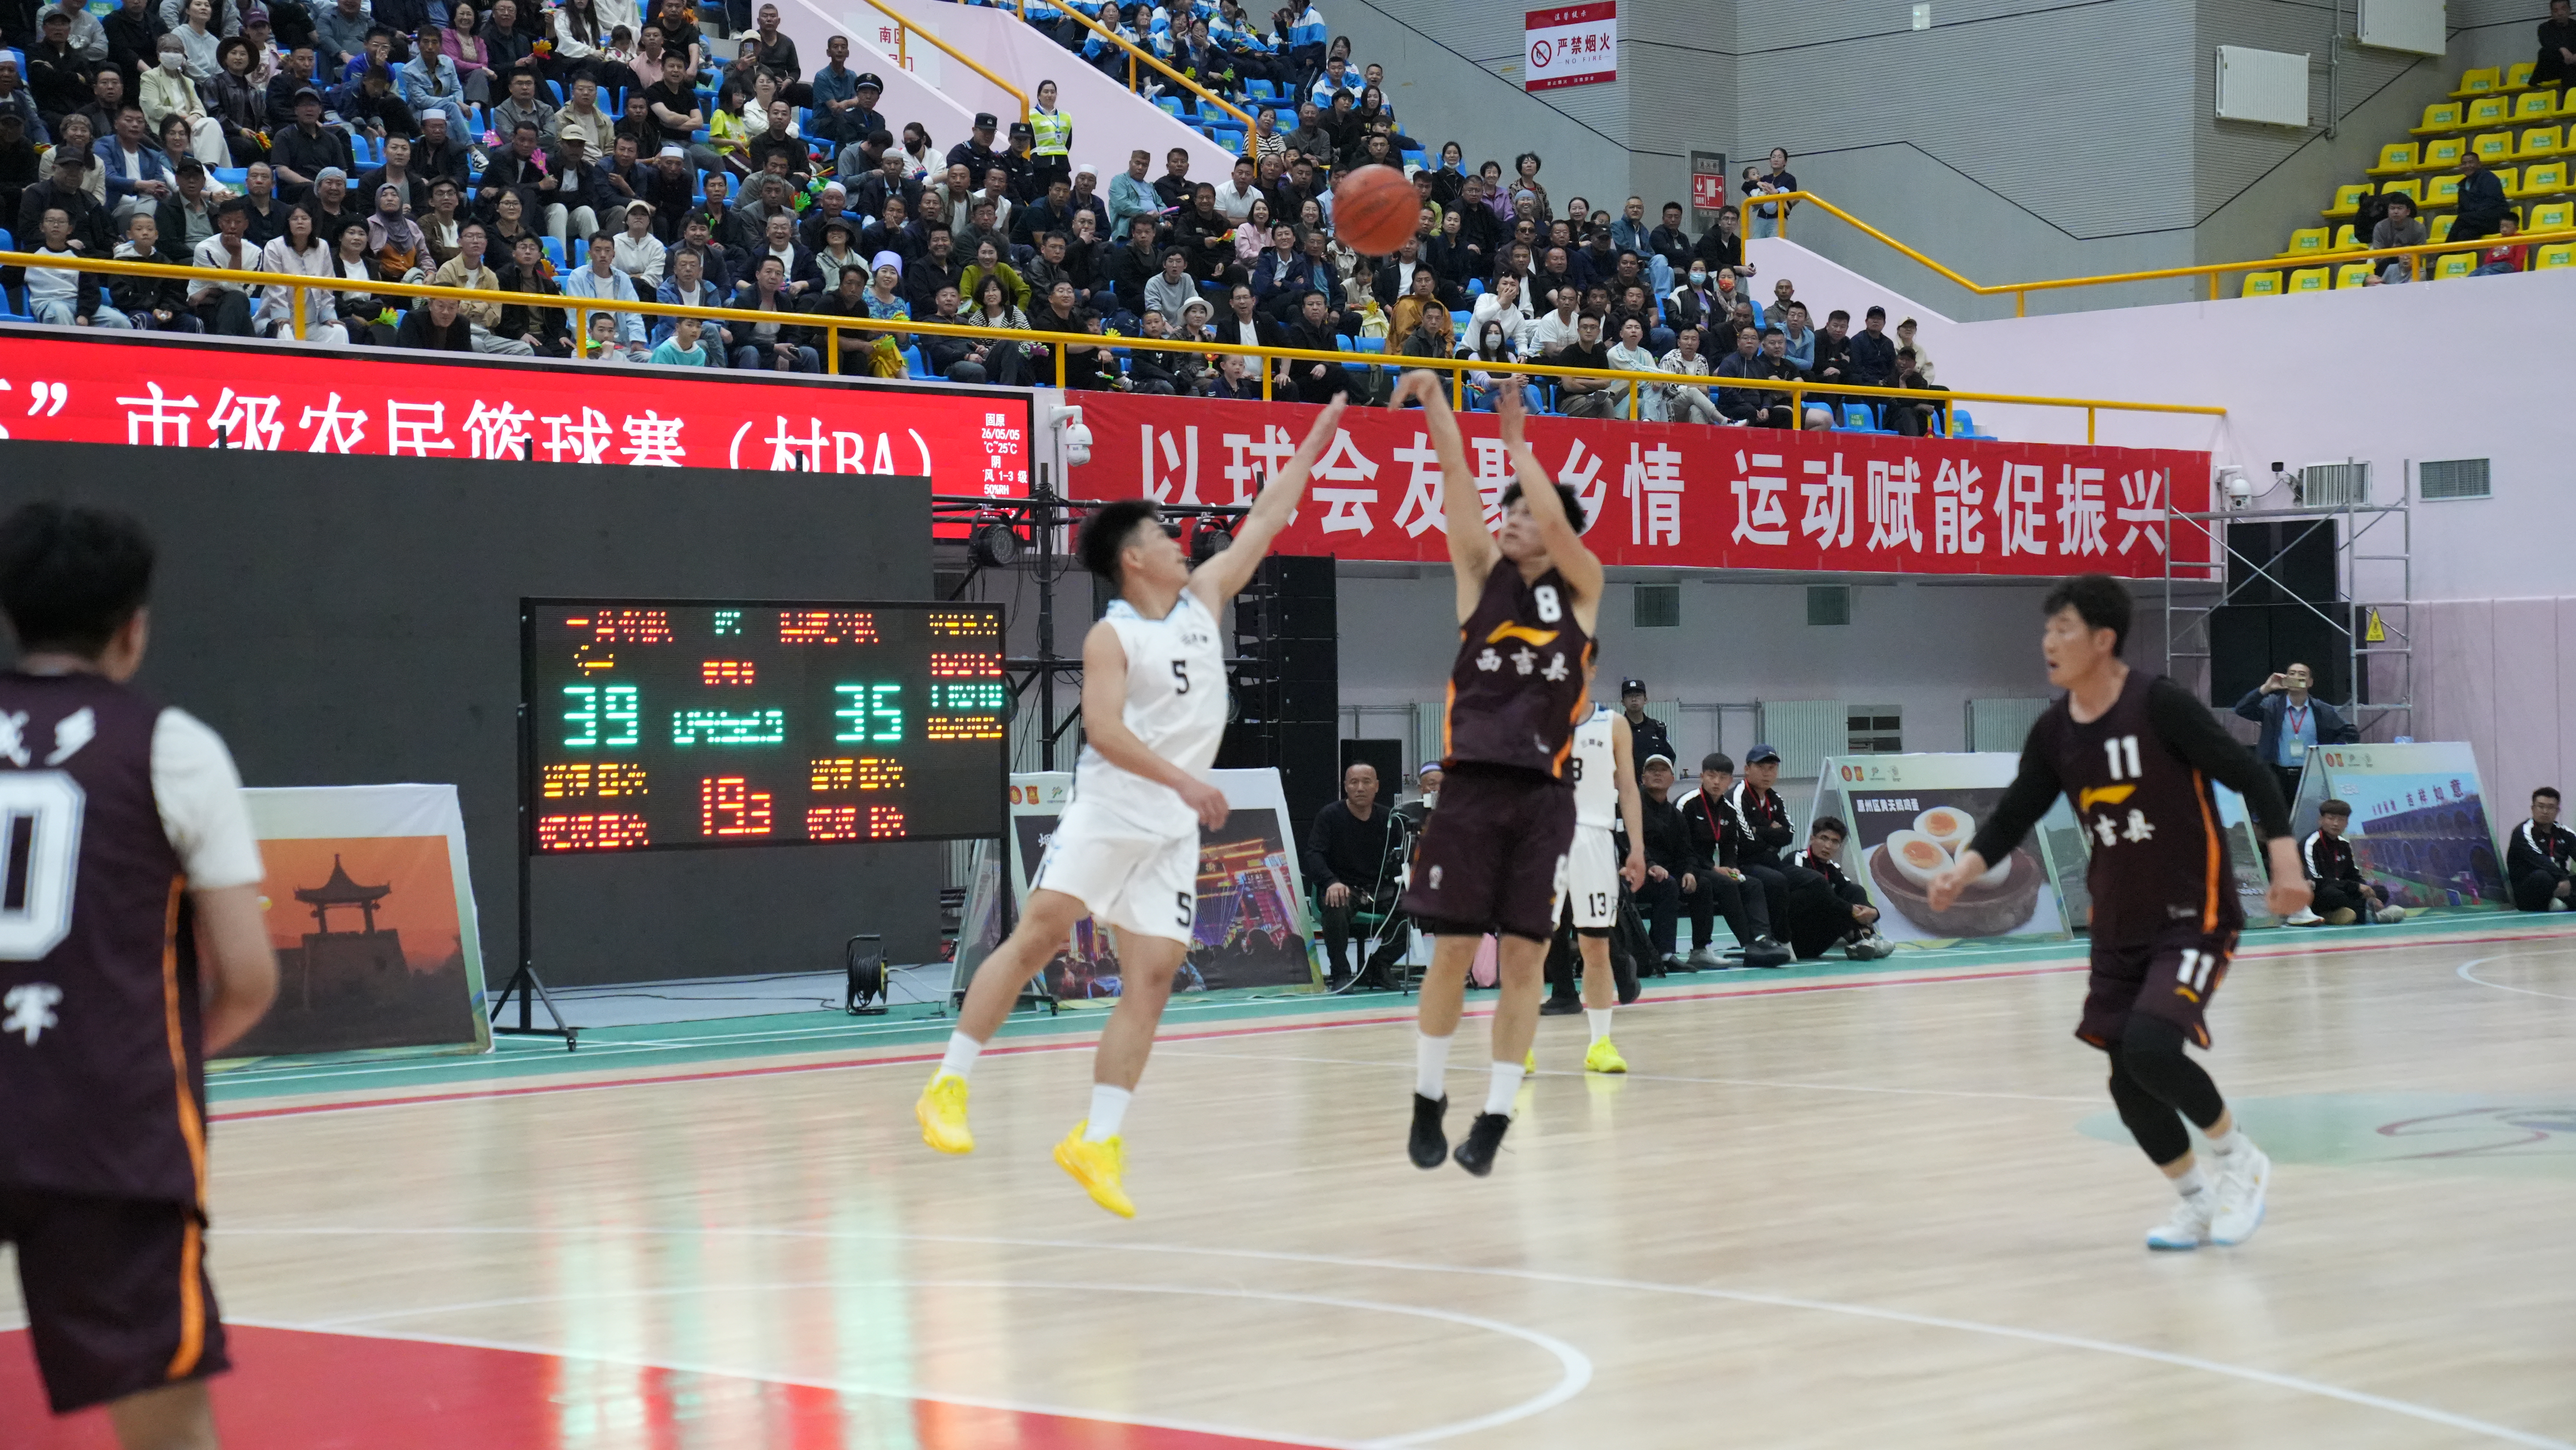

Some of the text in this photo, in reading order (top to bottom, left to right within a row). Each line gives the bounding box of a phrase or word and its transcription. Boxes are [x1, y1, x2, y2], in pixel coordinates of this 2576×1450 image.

[1557, 32, 1611, 56] 严禁烟火
[981, 428, 1020, 440] 26/05/05
[985, 413, 1005, 426] 固原
[982, 469, 1028, 483] 风 1-3 级
[991, 455, 1001, 468] 阴
[984, 484, 1009, 495] 50%RH
[1731, 449, 2166, 557] 运动赋能促振兴
[1534, 585, 1562, 623] 8
[1172, 660, 1189, 694] 5
[1475, 647, 1570, 682] 西吉县
[563, 686, 638, 745] 39
[835, 685, 902, 741] 35
[2104, 735, 2143, 780] 11
[2085, 809, 2156, 847] 吉县
[1176, 891, 1191, 928] 5
[1589, 892, 1606, 918] 13
[2177, 949, 2215, 994] 11
